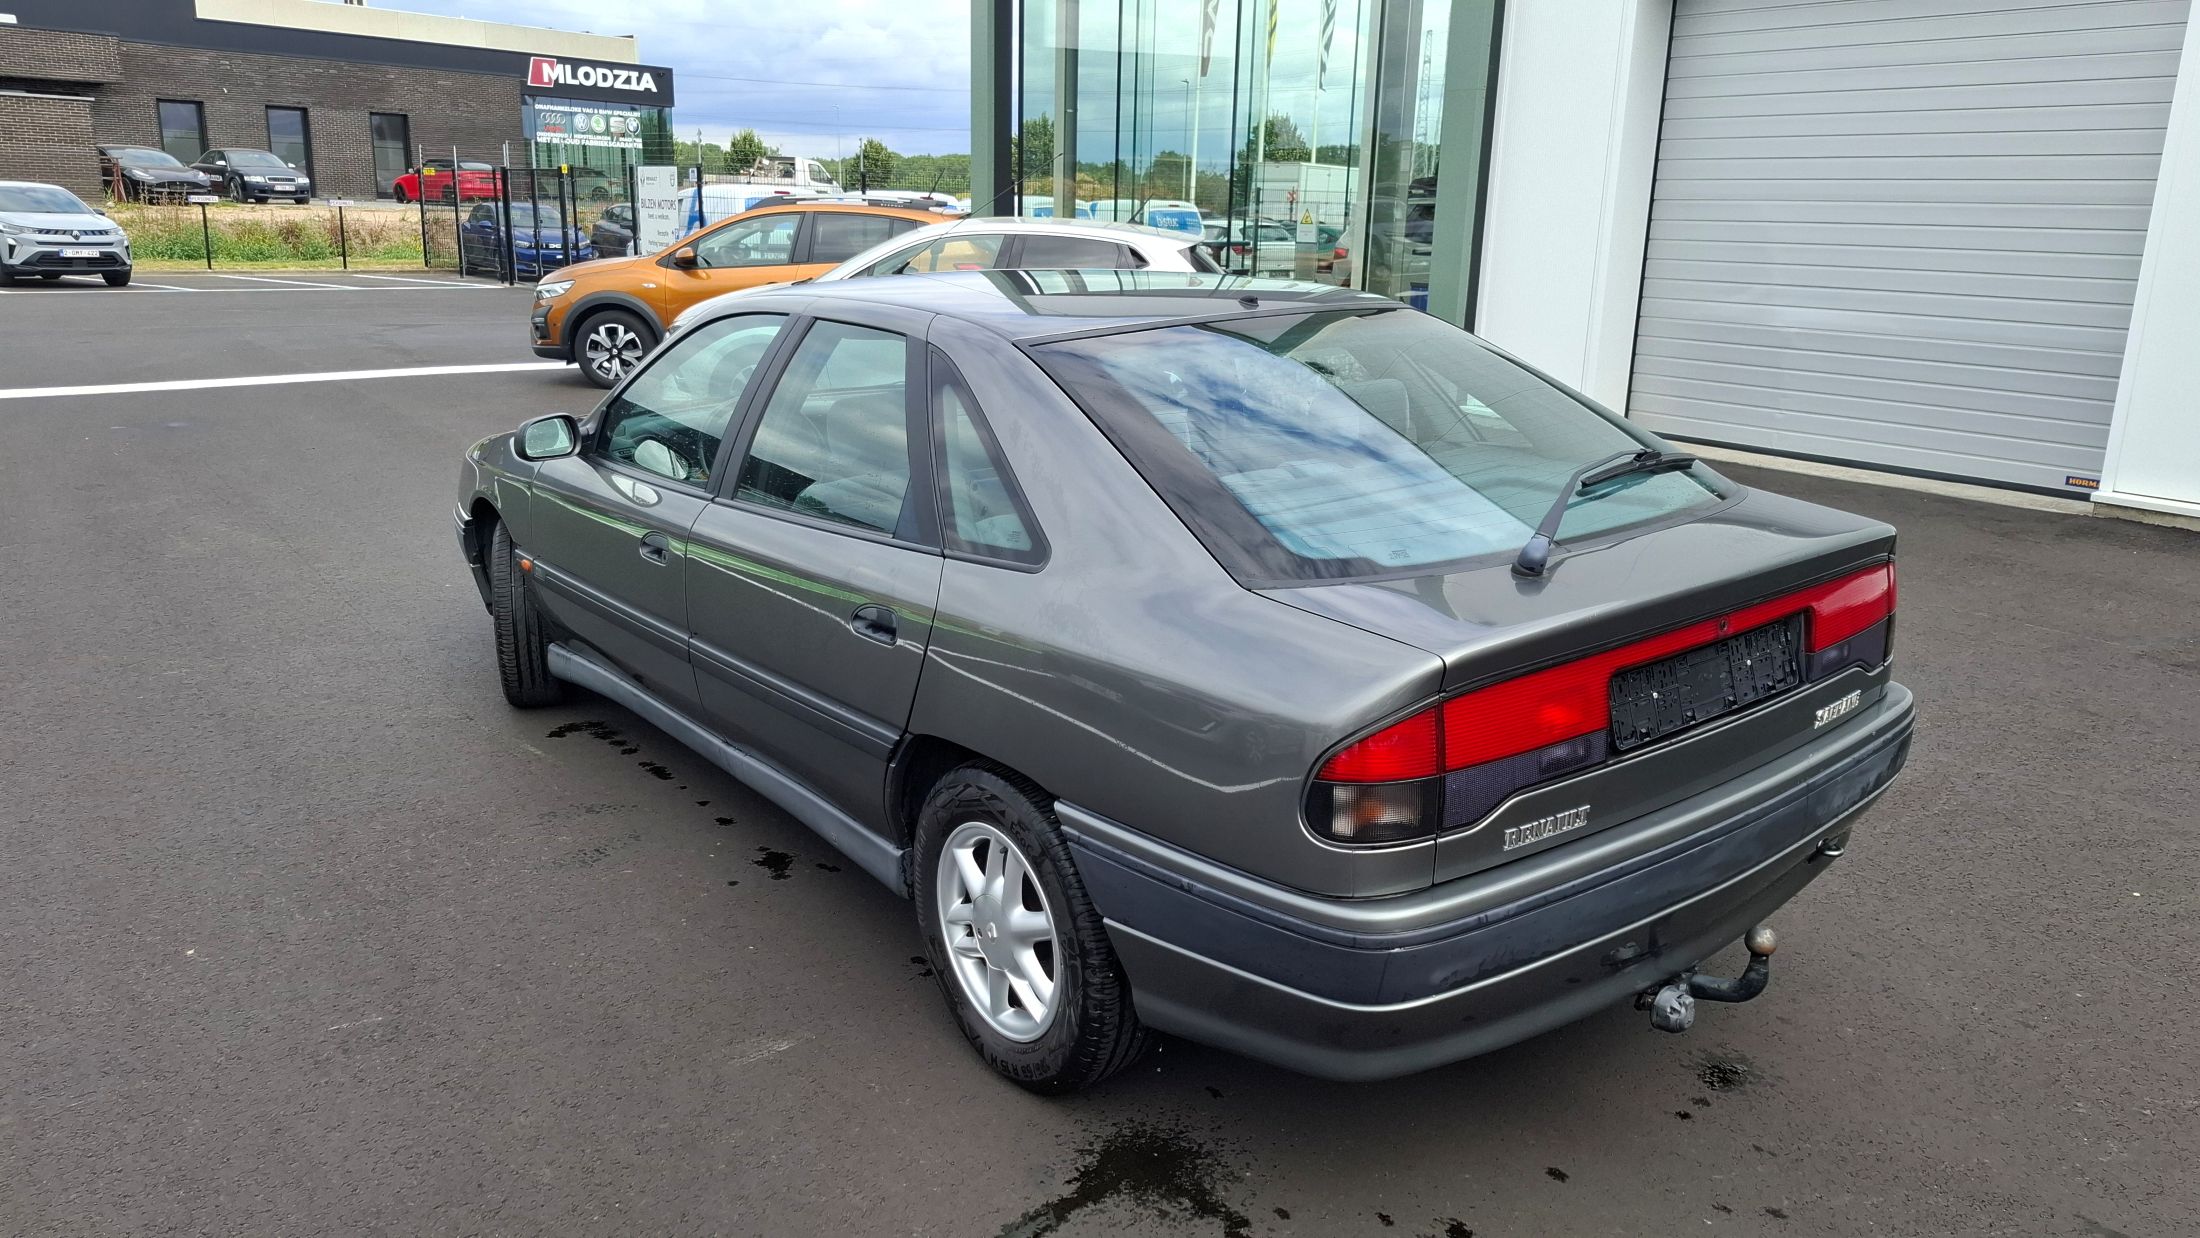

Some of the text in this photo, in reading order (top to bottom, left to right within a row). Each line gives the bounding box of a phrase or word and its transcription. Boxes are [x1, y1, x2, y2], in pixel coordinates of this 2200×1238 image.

[542, 62, 658, 93] MLODZIA
[2069, 478, 2099, 489] HORM
[1503, 804, 1591, 852] RENAULT
